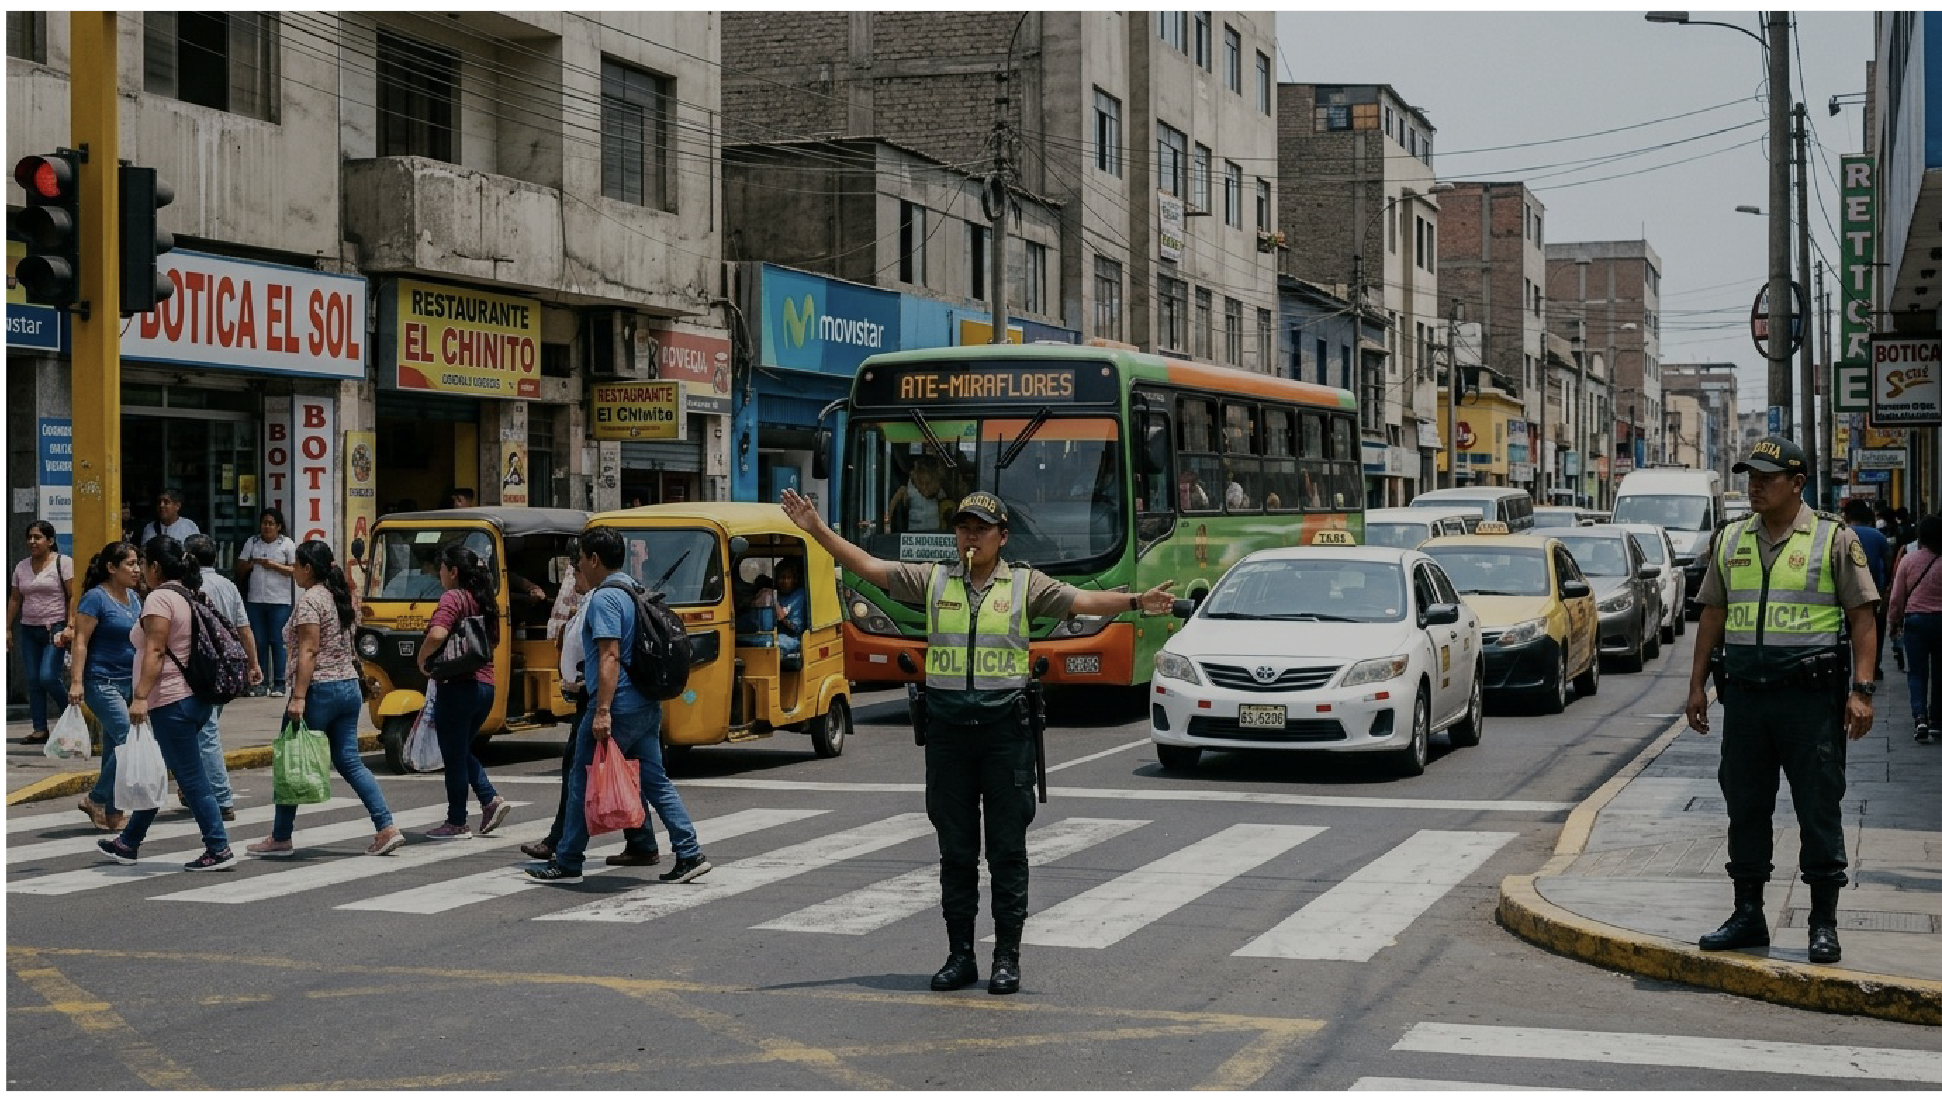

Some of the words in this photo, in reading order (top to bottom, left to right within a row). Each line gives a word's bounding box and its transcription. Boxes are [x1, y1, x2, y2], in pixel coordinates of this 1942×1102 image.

[266, 284, 299, 353] EL
[309, 289, 360, 360] SOL
[411, 288, 529, 329] RESTAURANTE
[405, 321, 435, 363] EL
[441, 326, 535, 374] CHINITO
[819, 315, 885, 348] movistar
[1875, 344, 1941, 362] BOTICA
[901, 374, 1072, 399] ATE-MIRAFLORES
